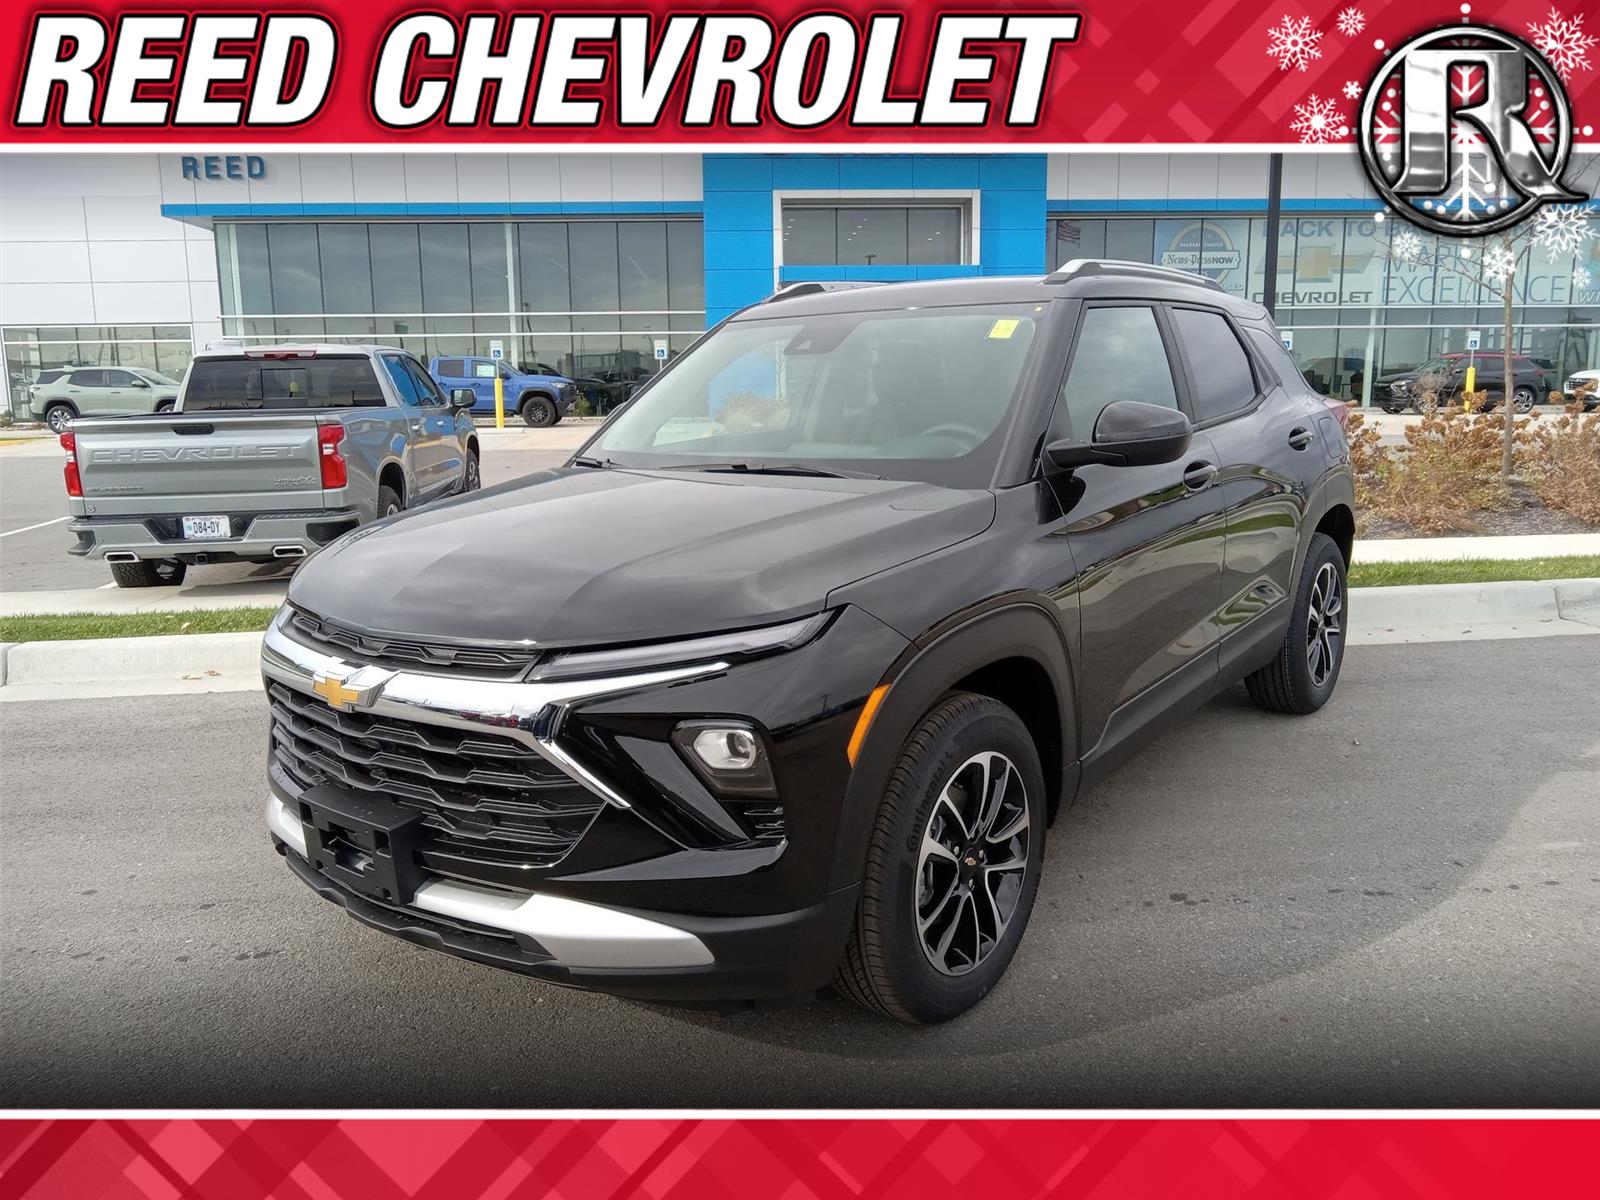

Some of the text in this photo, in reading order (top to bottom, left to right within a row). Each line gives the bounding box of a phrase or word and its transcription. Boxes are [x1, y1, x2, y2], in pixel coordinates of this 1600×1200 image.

[182, 155, 266, 180] REED
[1262, 219, 1334, 238] ACK
[1346, 219, 1377, 238] TO
[92, 445, 301, 463] CHEVROLET
